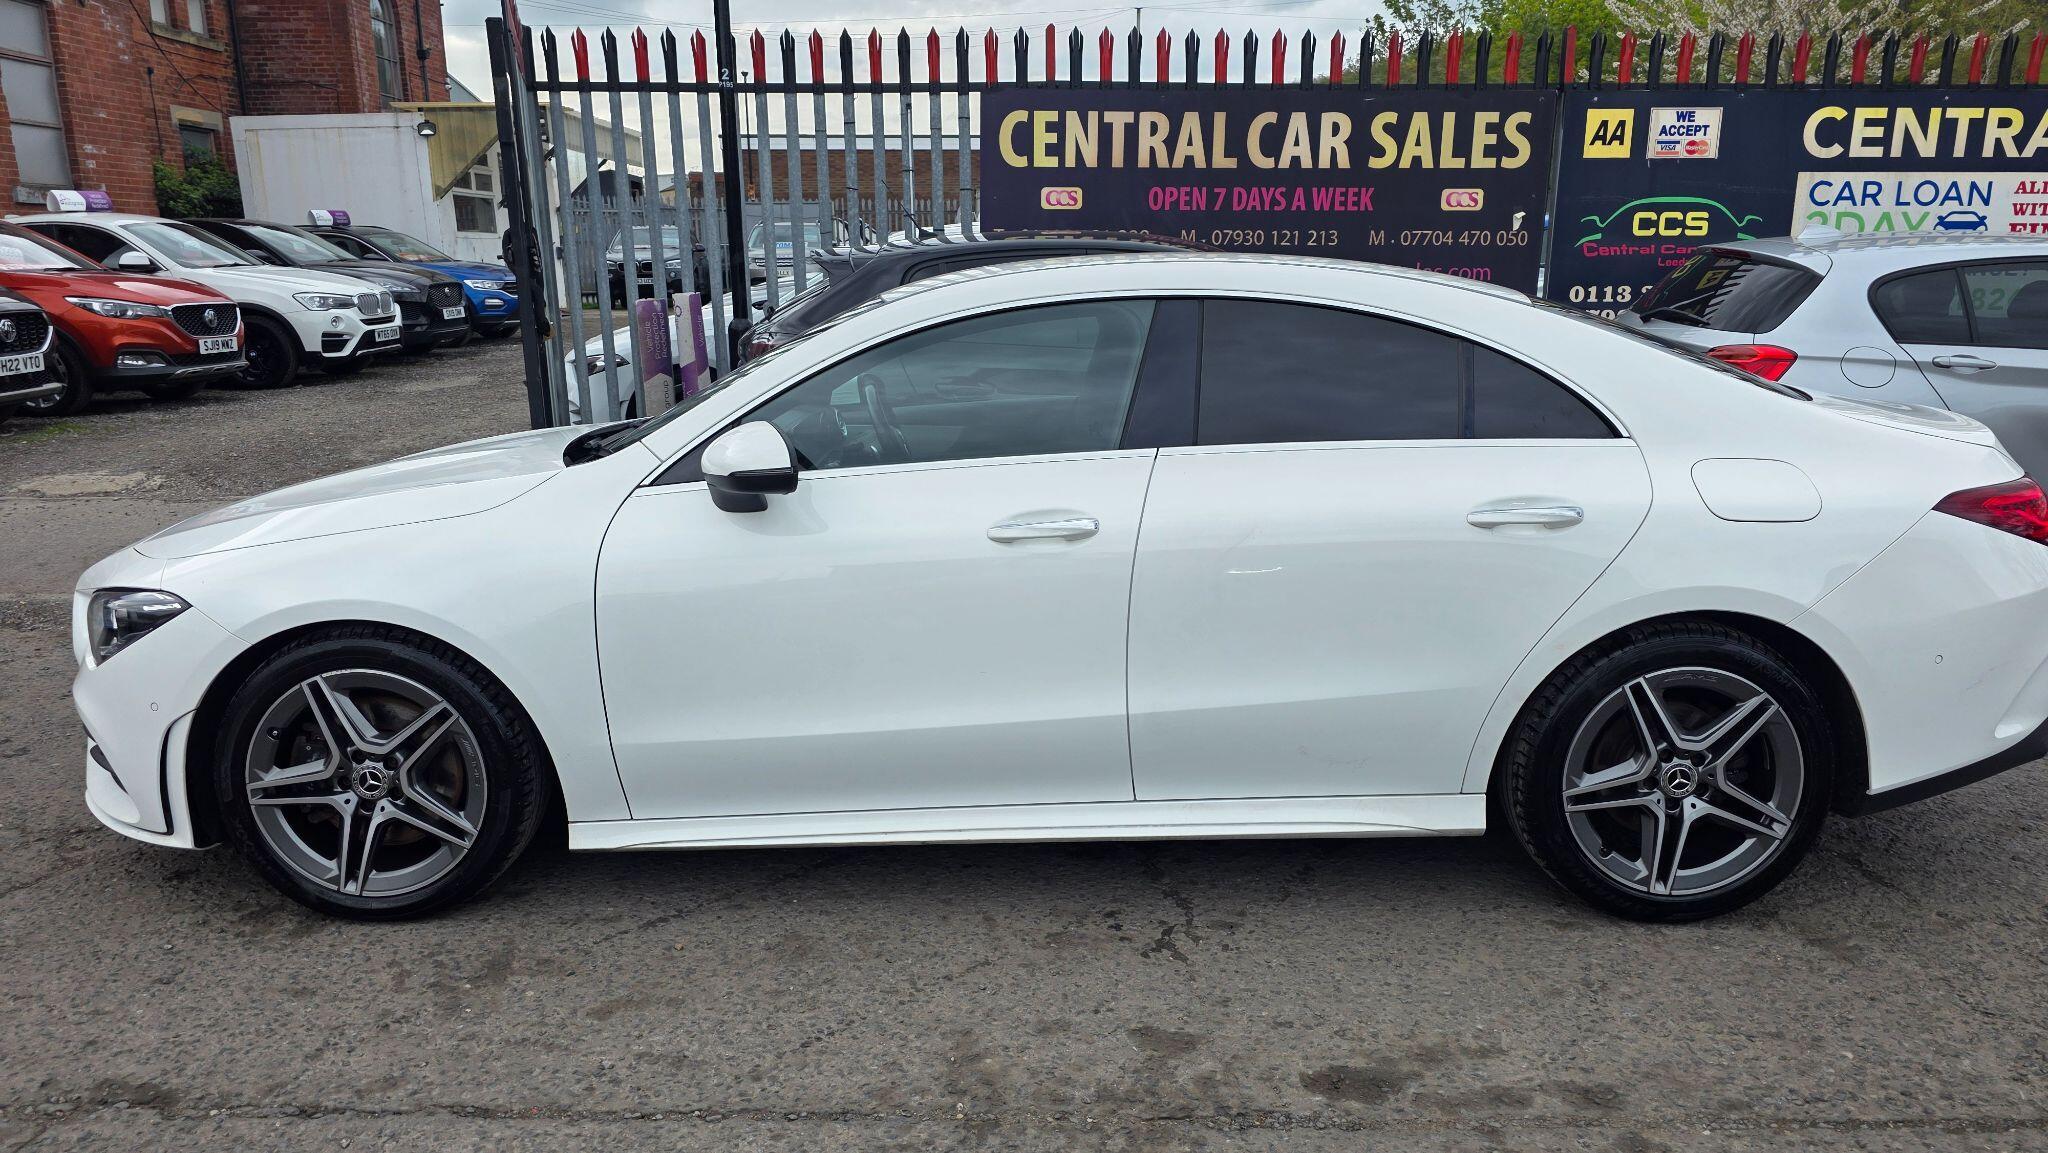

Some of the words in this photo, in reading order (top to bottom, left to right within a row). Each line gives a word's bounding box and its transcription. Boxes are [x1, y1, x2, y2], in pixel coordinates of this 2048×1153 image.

[721, 68, 730, 80] 2
[1675, 111, 1696, 123] WE
[998, 109, 1238, 169] CENTRAL
[1247, 111, 1352, 169] CAR
[1367, 111, 1533, 169] SALES
[1589, 119, 1627, 146] AA
[1658, 125, 1710, 137] ACCEPT
[1045, 190, 1079, 207] CCS
[1148, 187, 1207, 211] OPEN
[1213, 187, 1227, 211] 7
[1232, 187, 1286, 211] DAYS
[1290, 187, 1306, 211] A
[1312, 187, 1375, 211] WEEK
[1445, 191, 1479, 208] CCS
[1808, 180, 1883, 206] CAR
[1894, 180, 1993, 206] LOAN
[1632, 211, 1710, 237] CCS
[1211, 229, 1265, 246] 07930
[1271, 229, 1299, 246] 121
[1306, 229, 1339, 246] 213
[1400, 229, 1454, 246] 07704
[1458, 229, 1491, 246] 470
[1496, 229, 1529, 246] 050
[1583, 243, 1656, 257] Central
[1661, 244, 1697, 255] Car
[1657, 257, 1689, 267] Leed
[1569, 285, 1632, 303] 0113
[644, 321, 652, 353] Vehicle
[652, 312, 661, 360] Protection
[659, 312, 668, 358] Redefined
